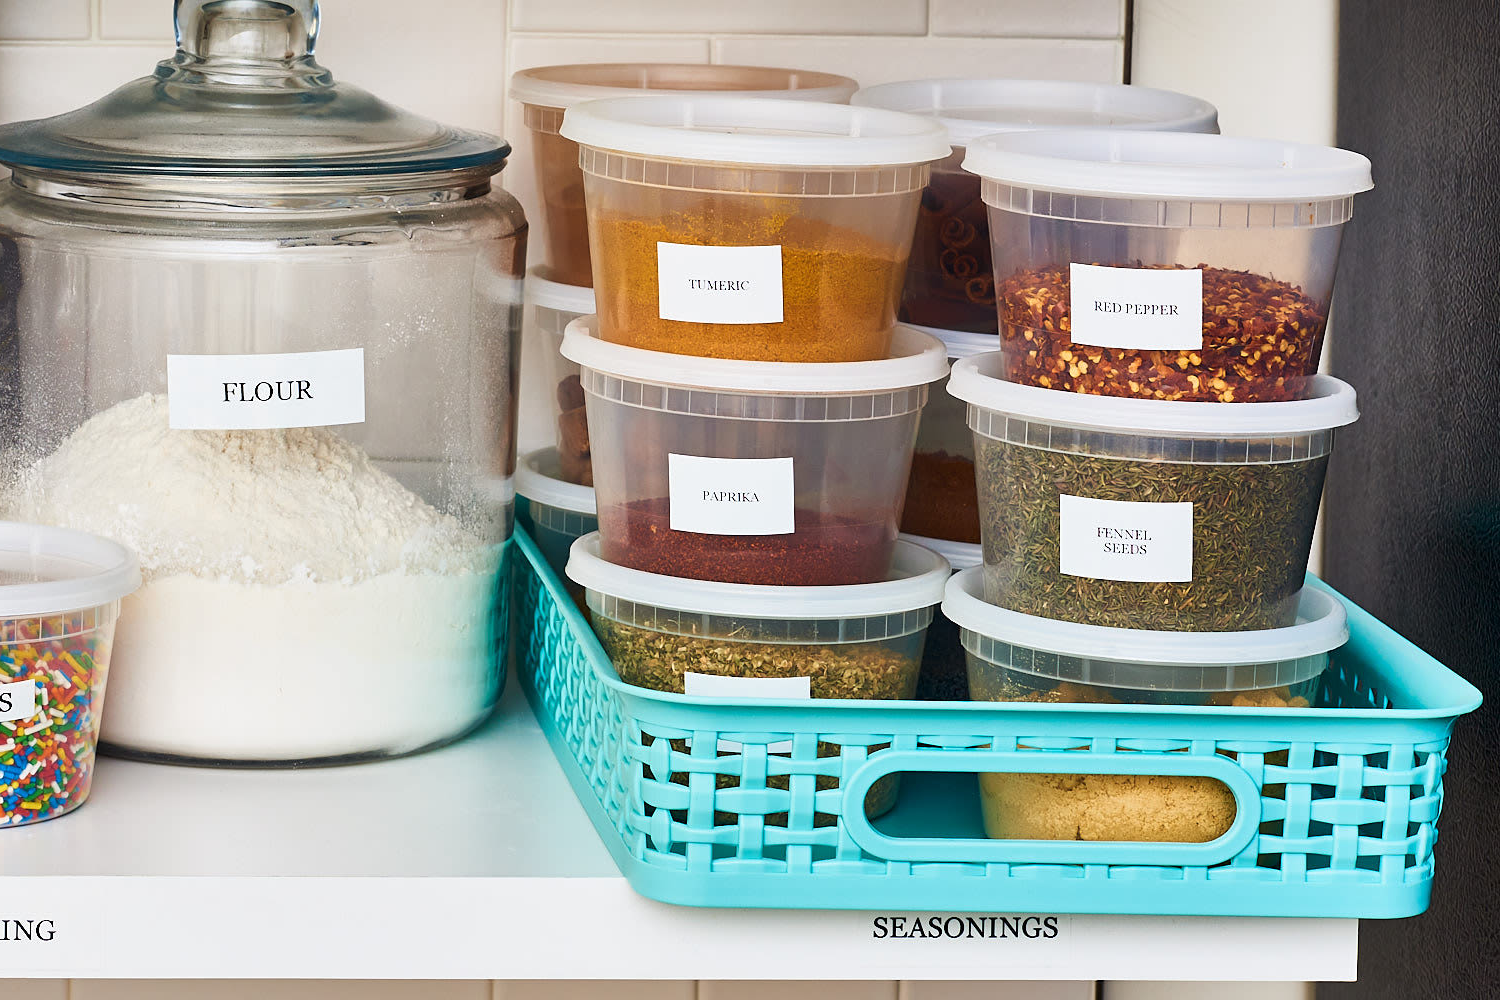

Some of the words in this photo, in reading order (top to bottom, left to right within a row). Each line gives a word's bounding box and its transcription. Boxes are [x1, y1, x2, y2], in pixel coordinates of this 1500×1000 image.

[688, 279, 750, 291] TUMERIC
[1094, 300, 1122, 313] RED
[1125, 303, 1179, 315] PEPPER
[222, 379, 314, 402] FLOUR
[702, 490, 760, 502] PAPRIKA
[1097, 527, 1152, 541] FENNEL
[1103, 542, 1148, 555] SEEDS
[872, 915, 1059, 939] SEASONINGS
